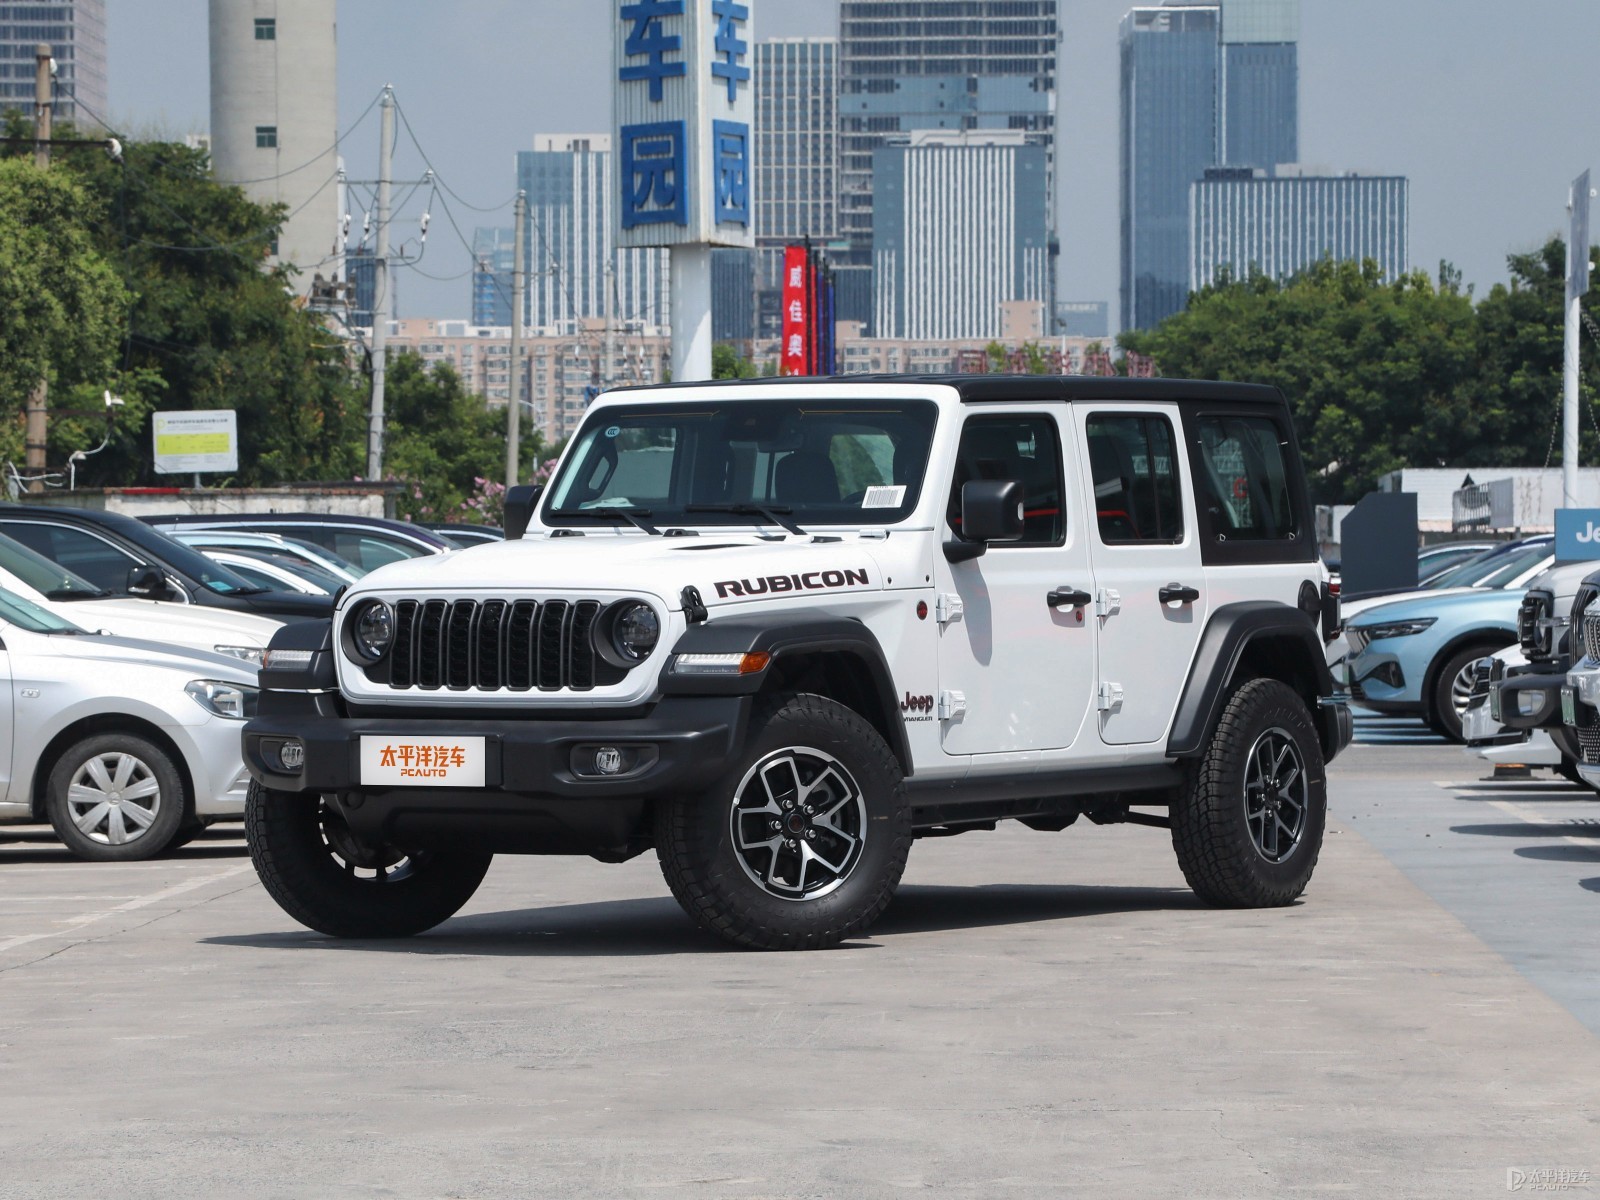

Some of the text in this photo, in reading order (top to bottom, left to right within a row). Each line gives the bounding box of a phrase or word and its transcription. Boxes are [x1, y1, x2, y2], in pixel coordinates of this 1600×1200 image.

[788, 265, 802, 375] 威佳奥
[714, 568, 869, 598] RUBICON
[901, 691, 934, 714] Jeep
[380, 745, 465, 767] 太平洋汽车
[401, 769, 447, 777] PCAUTO
